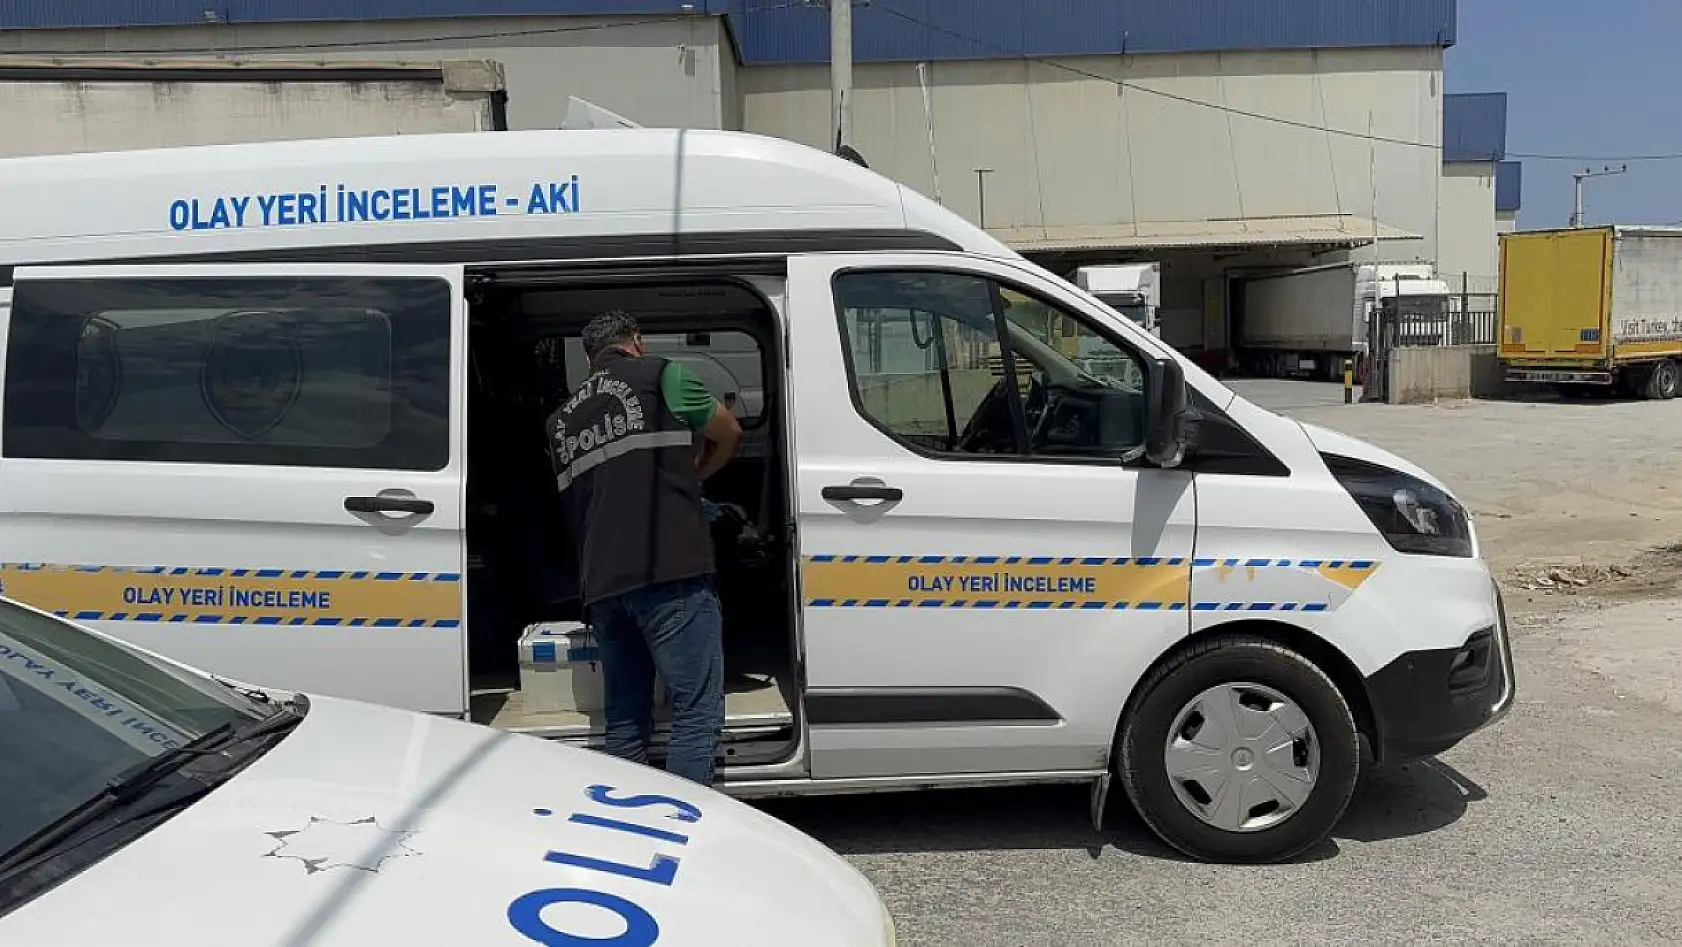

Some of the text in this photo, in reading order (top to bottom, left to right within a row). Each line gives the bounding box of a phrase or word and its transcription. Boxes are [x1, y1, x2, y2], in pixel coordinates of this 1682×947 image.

[170, 175, 579, 230] OLAY YERİ İNCELEME - AKİ
[908, 573, 1096, 592] OLAY YERİ İNCELEME
[123, 586, 330, 608] OLAY YERİ İNCELEME
